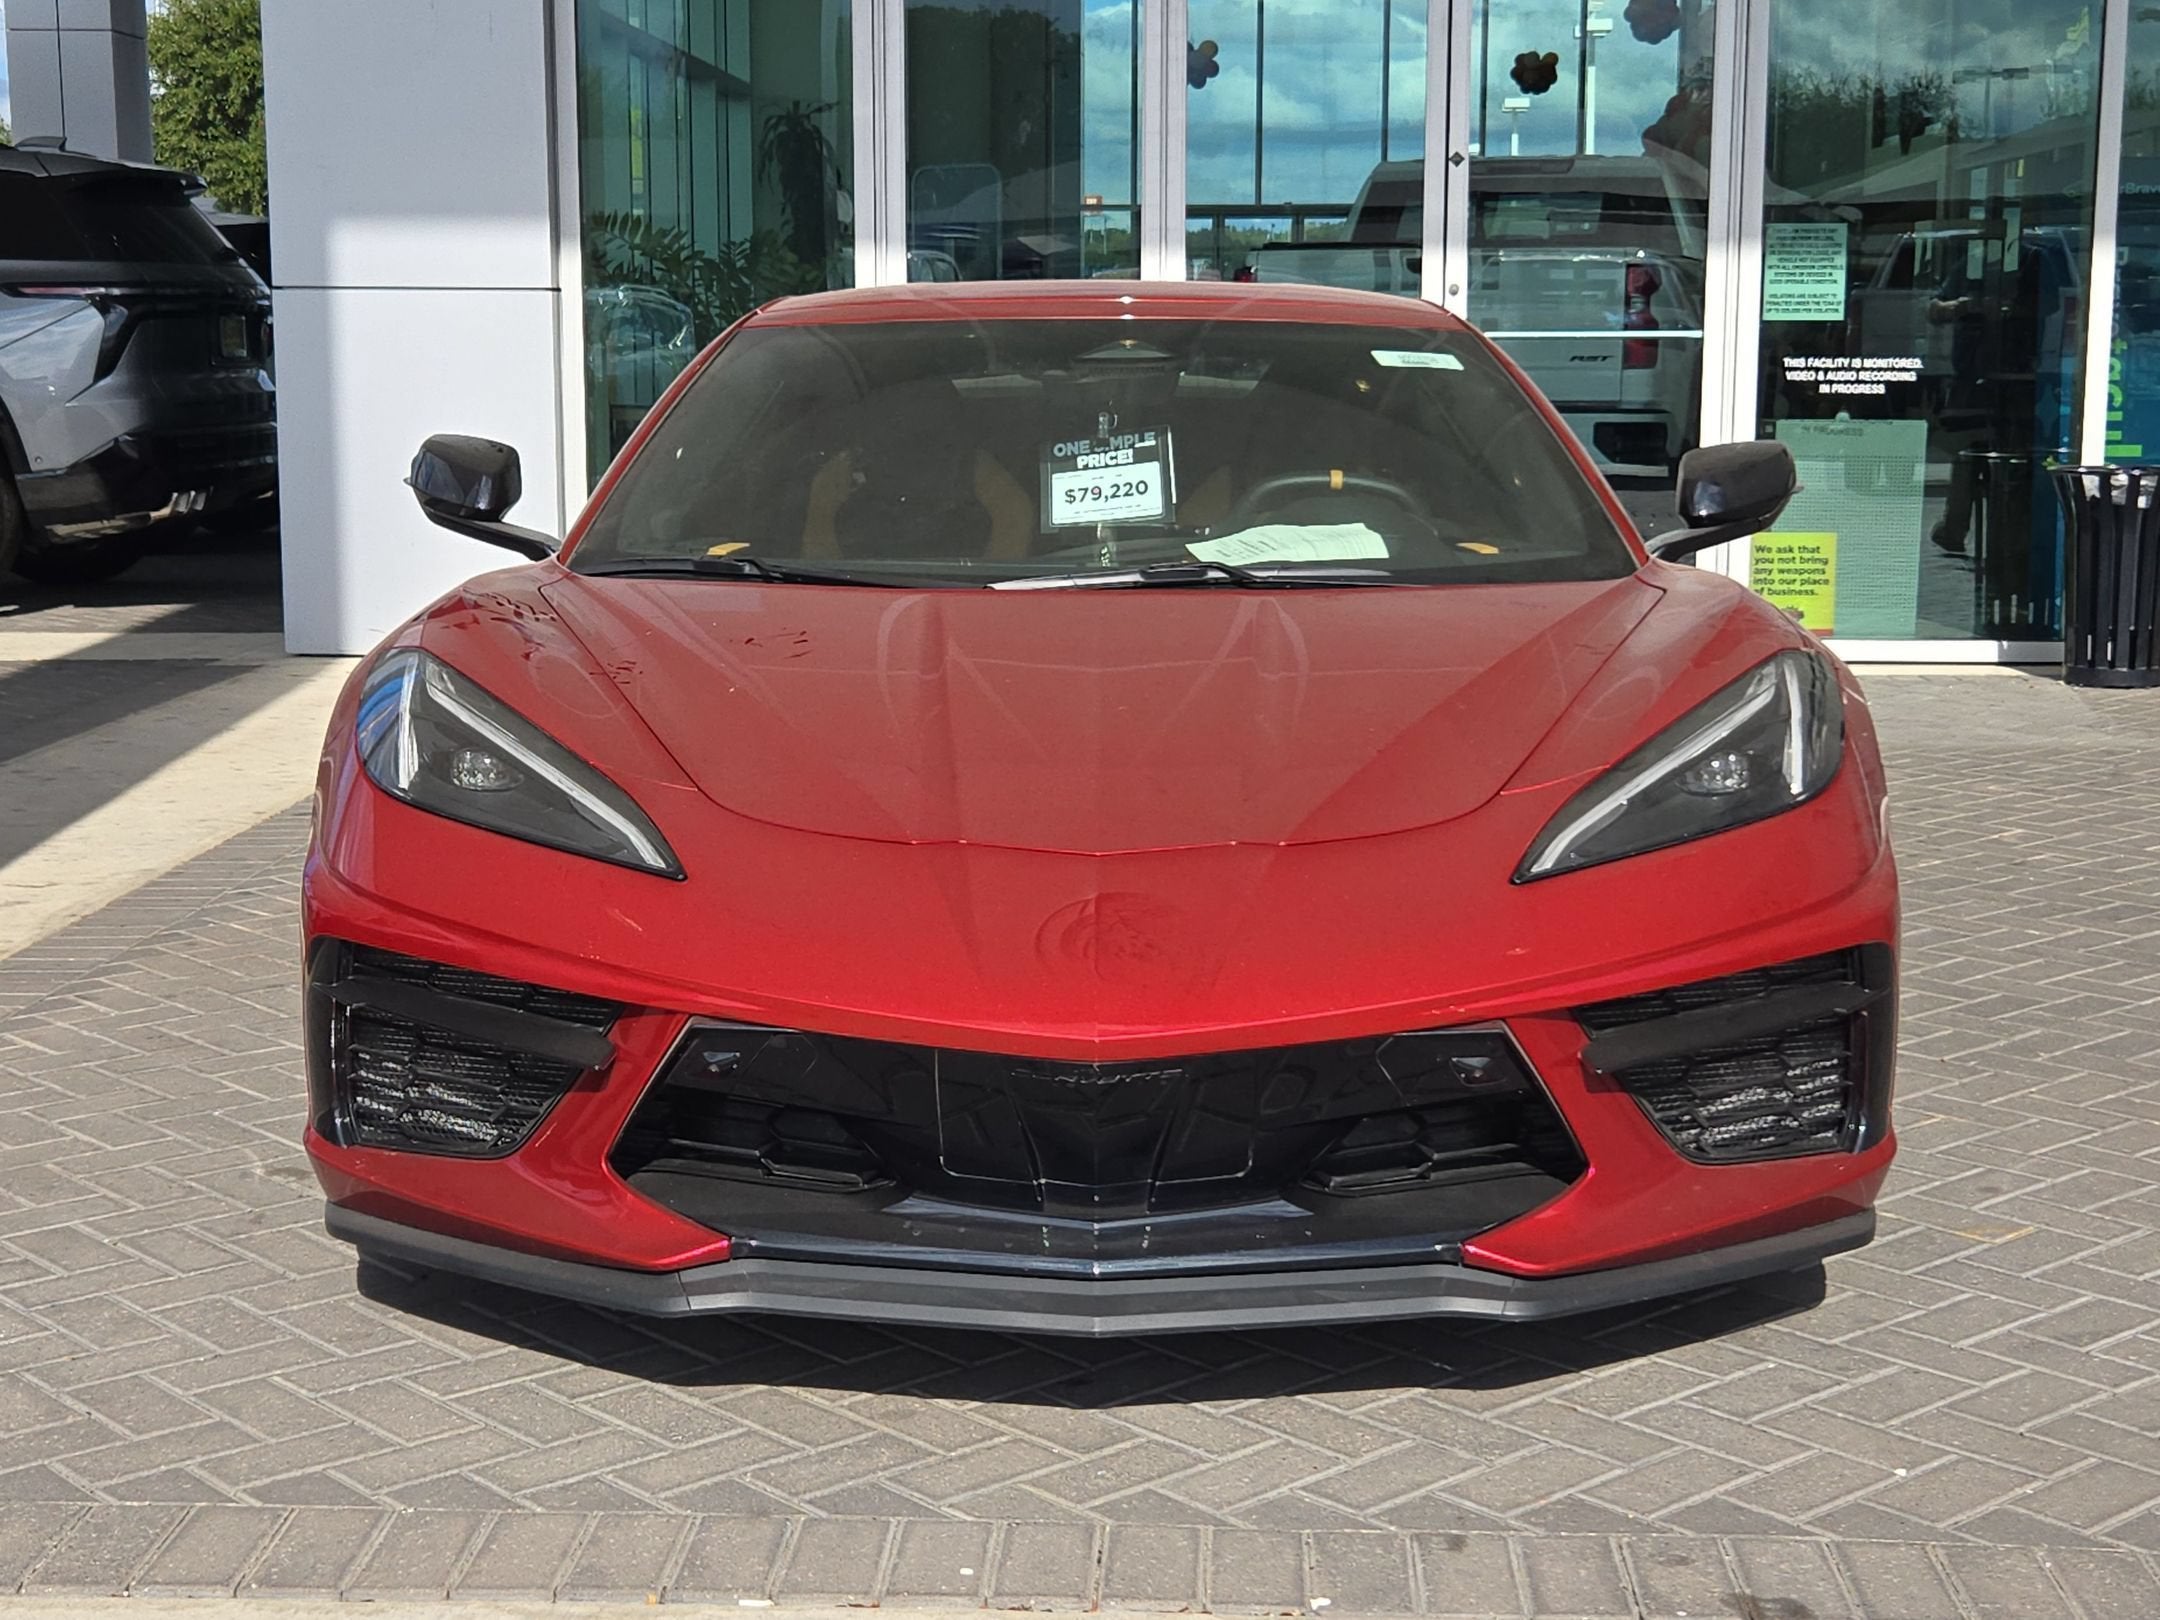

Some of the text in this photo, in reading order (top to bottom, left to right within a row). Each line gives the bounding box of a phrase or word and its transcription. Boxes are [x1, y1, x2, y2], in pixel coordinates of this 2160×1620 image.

[1782, 357, 1806, 369] THIS
[1807, 357, 1850, 369] FACILITY
[1851, 357, 1862, 369] IS
[1785, 370, 1917, 381] VIDEO & AUDIO RECORDING
[1819, 383, 1886, 394] IN PROGRESS
[1053, 431, 1156, 457] ONE MPLE
[1076, 448, 1134, 469] PRICE!
[1065, 480, 1149, 504] $79,220
[1754, 545, 1821, 553] We ask that
[1754, 556, 1829, 566] you not bring
[1753, 568, 1826, 576] any weapons
[1753, 577, 1775, 585] into
[1800, 577, 1829, 586] place
[1767, 587, 1819, 596] business.
